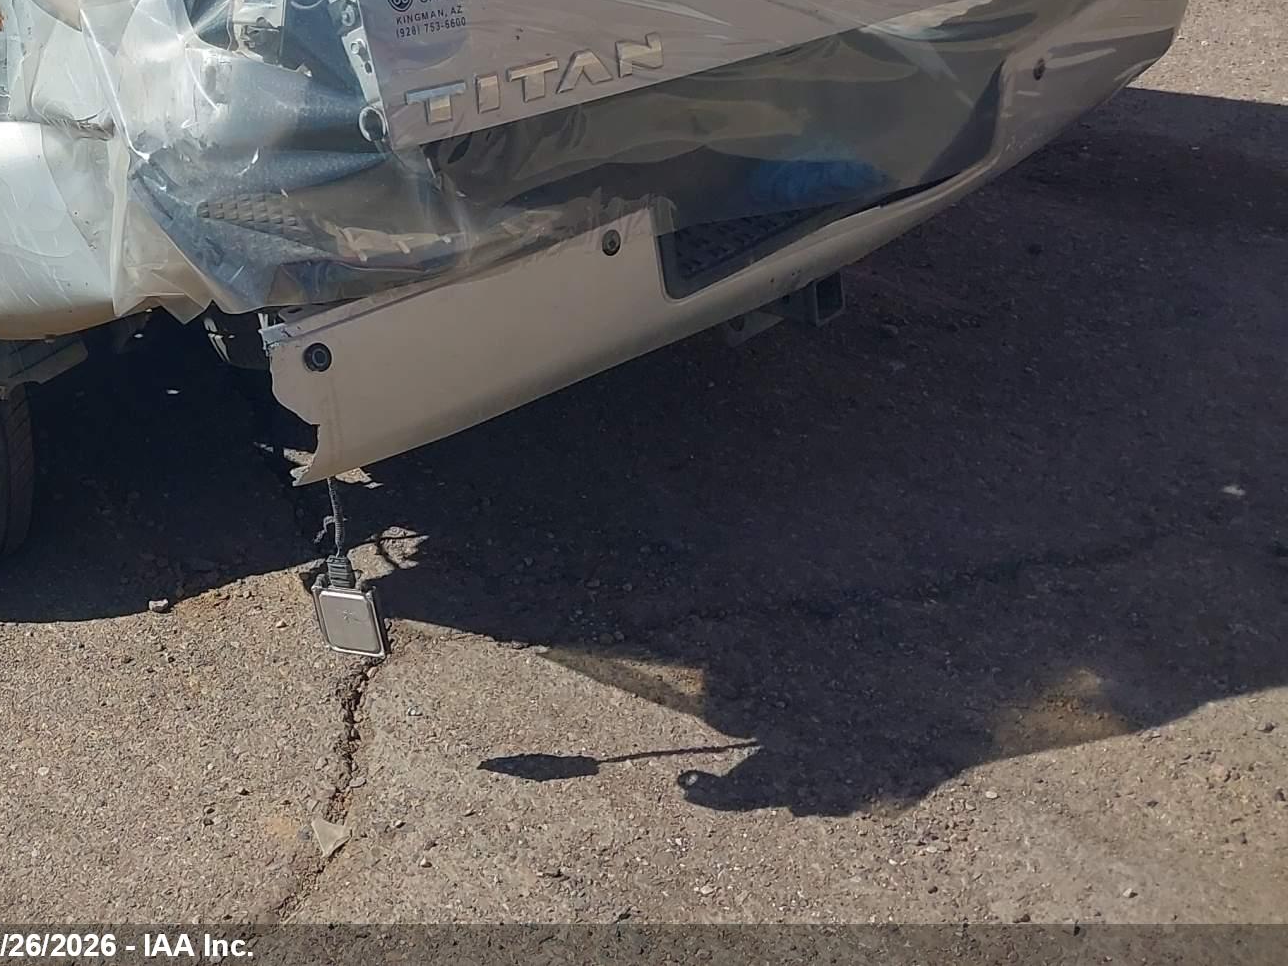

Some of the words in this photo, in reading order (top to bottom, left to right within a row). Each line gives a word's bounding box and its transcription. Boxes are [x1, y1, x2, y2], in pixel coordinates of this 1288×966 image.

[396, 9, 448, 25] KINGMAN,
[451, 5, 463, 15] AZ
[405, 31, 663, 125] TITAN
